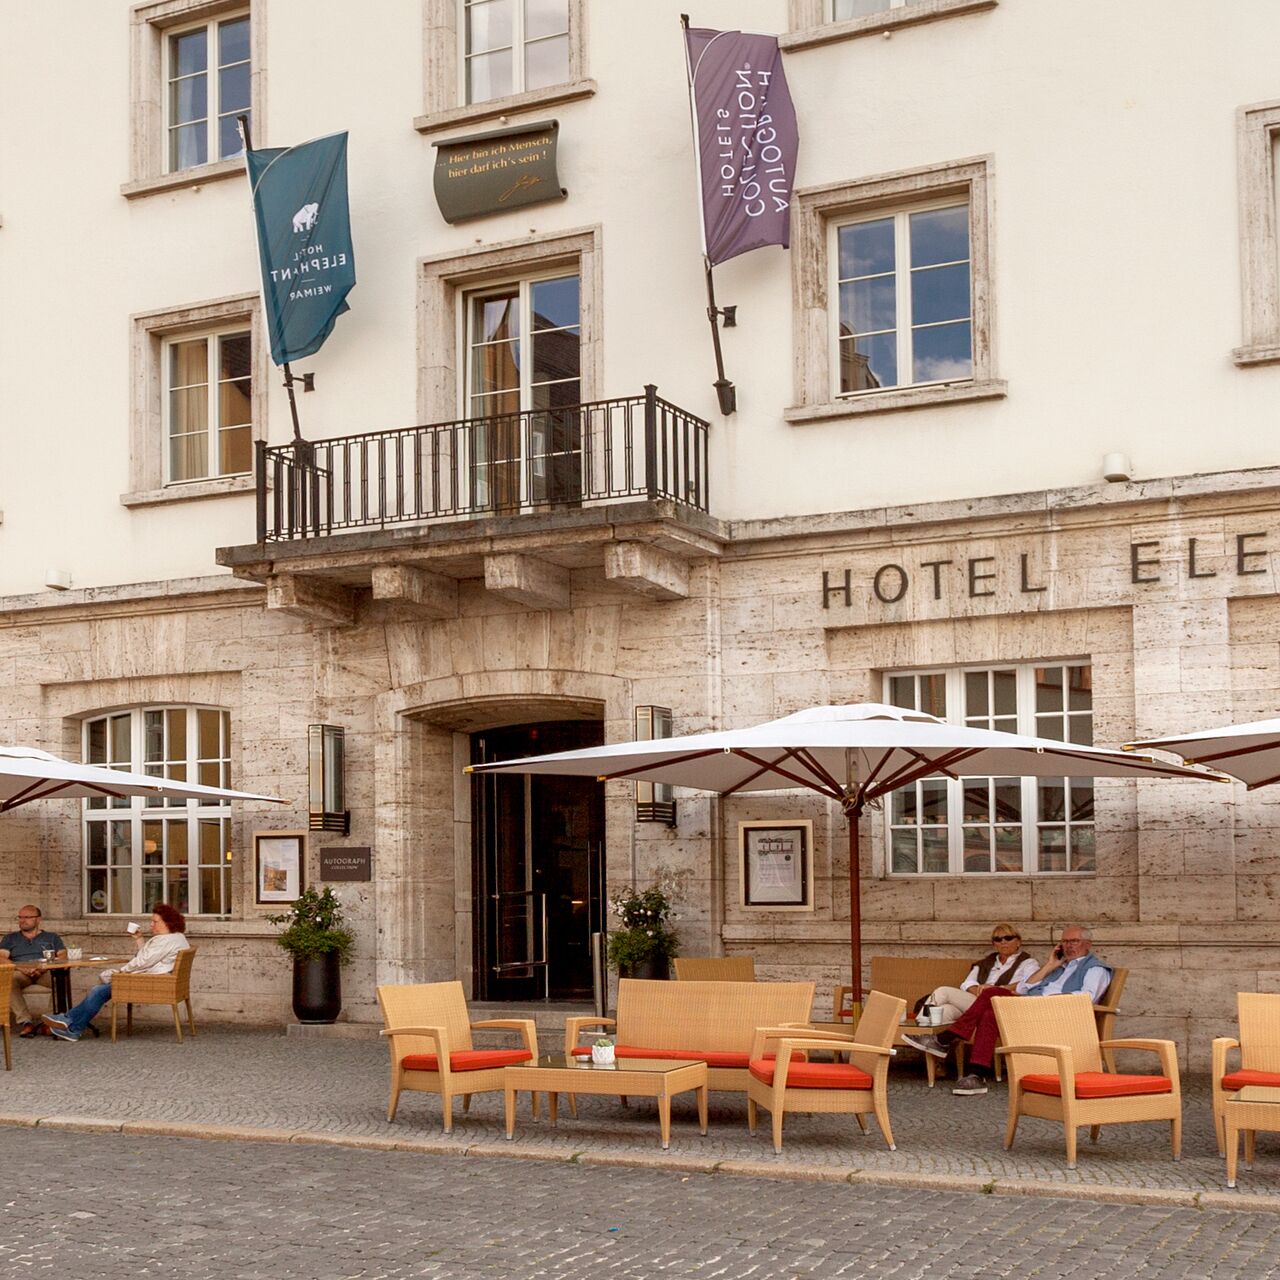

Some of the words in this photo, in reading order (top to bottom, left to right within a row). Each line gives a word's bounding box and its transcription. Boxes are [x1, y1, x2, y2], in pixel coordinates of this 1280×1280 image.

[448, 167, 468, 179] hier
[470, 162, 491, 175] darf
[518, 153, 540, 165] sein
[449, 153, 472, 165] Hier
[472, 149, 489, 160] bin
[491, 145, 507, 156] ich
[822, 553, 1048, 610] HOTEL
